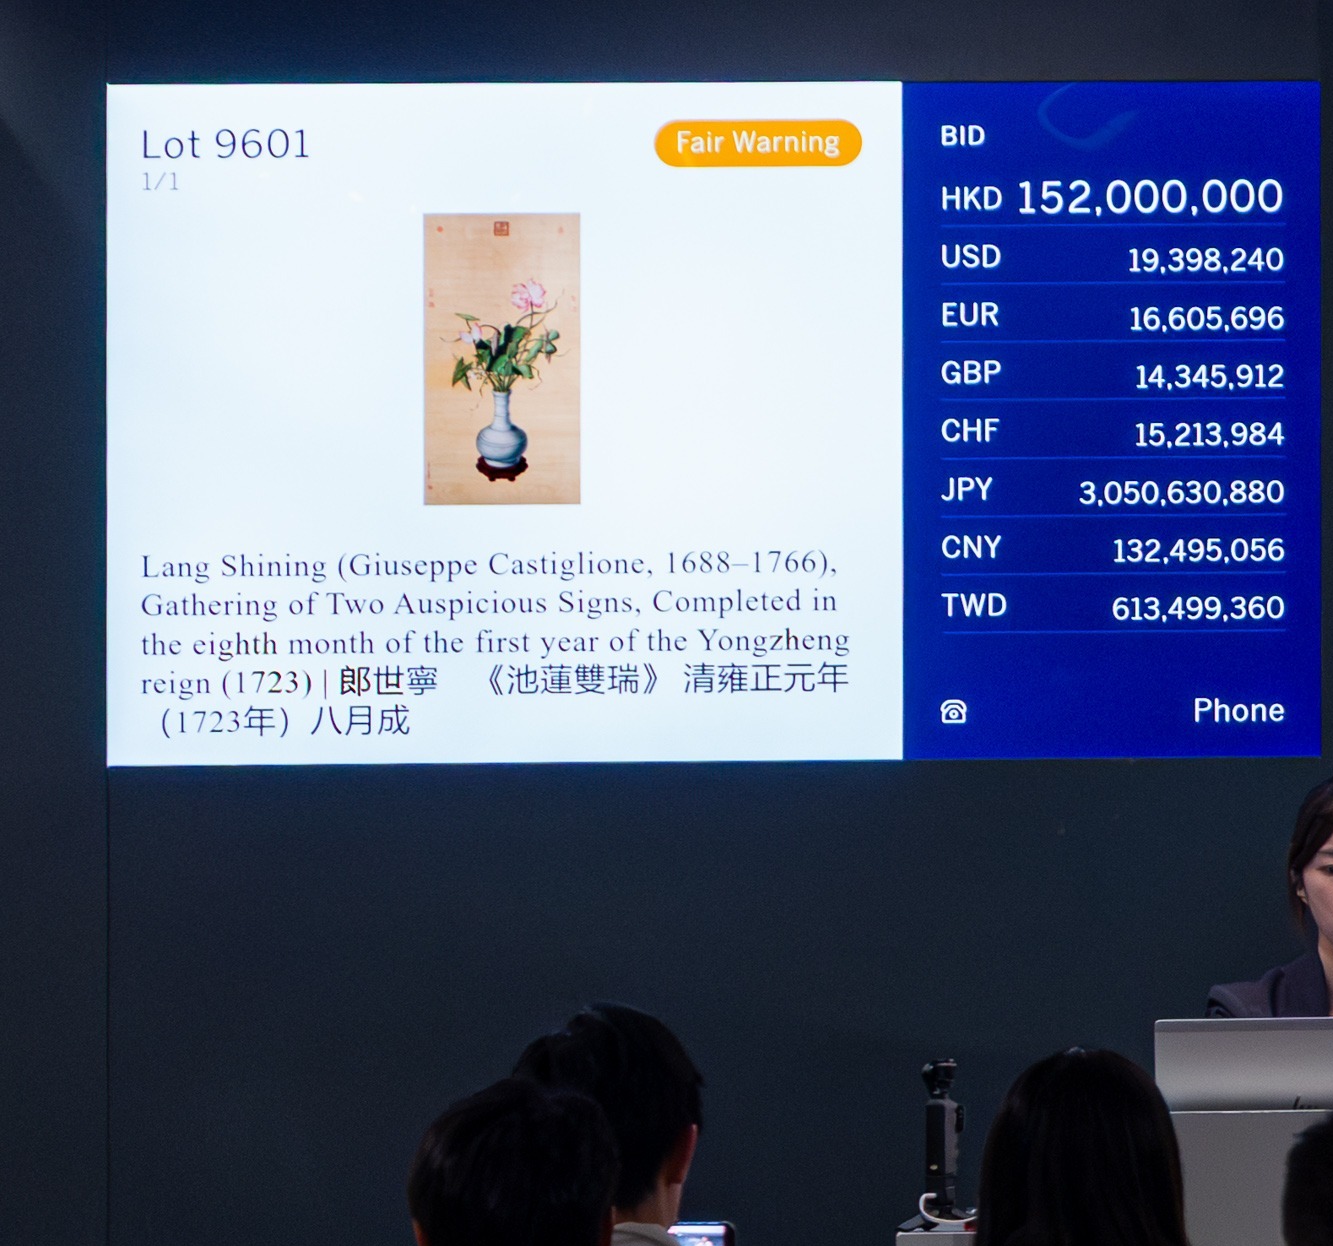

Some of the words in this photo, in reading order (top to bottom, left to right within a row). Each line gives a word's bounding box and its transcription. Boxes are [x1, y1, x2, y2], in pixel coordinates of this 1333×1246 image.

[144, 130, 200, 159] Lot
[216, 129, 308, 158] 9601
[677, 131, 724, 153] Fair
[733, 131, 840, 158] Warning
[941, 125, 985, 146] BID
[144, 172, 177, 190] 1/1
[942, 186, 1002, 210] HKD
[1019, 179, 1282, 216] 152,000,000
[942, 244, 1001, 268] USD
[1129, 247, 1283, 274] 19,398,240
[942, 302, 998, 326] EUR
[1131, 306, 1284, 332] 16,605,696
[941, 360, 1001, 384] GBP
[1136, 364, 1283, 390] 14,345,912
[941, 418, 999, 442] CHF
[1136, 422, 1284, 448] 15,213,984
[941, 477, 992, 501] JPY
[1079, 480, 1284, 506] 3,050,630,880
[942, 535, 1001, 558] CNY
[1114, 538, 1284, 564] 132,495,056
[143, 555, 209, 584] Lang
[222, 554, 326, 583] Shining
[338, 553, 477, 582] (Giuseppe
[489, 551, 652, 581] Castiglione,
[141, 593, 277, 622] Gathering
[289, 592, 319, 615] of
[326, 593, 384, 614] Two
[394, 591, 546, 620] Auspicious
[559, 590, 640, 619] Signs,
[653, 588, 800, 618] Completed
[814, 588, 836, 611] in
[941, 593, 1007, 617] TWD
[1113, 596, 1284, 622] 613,499,360
[142, 633, 181, 655] the
[193, 632, 277, 662] eighth
[290, 631, 374, 654] month
[386, 630, 416, 653] of
[424, 630, 463, 653] the
[477, 630, 529, 652] first
[541, 637, 599, 659] year
[610, 628, 639, 651] of
[648, 629, 687, 651] the
[698, 628, 849, 657] Yongzheng
[142, 671, 210, 700] reign
[222, 671, 311, 699] (1723)
[340, 665, 437, 696] 郎世寧
[684, 661, 848, 693] 清雍正元年
[1195, 698, 1284, 722] Phone
